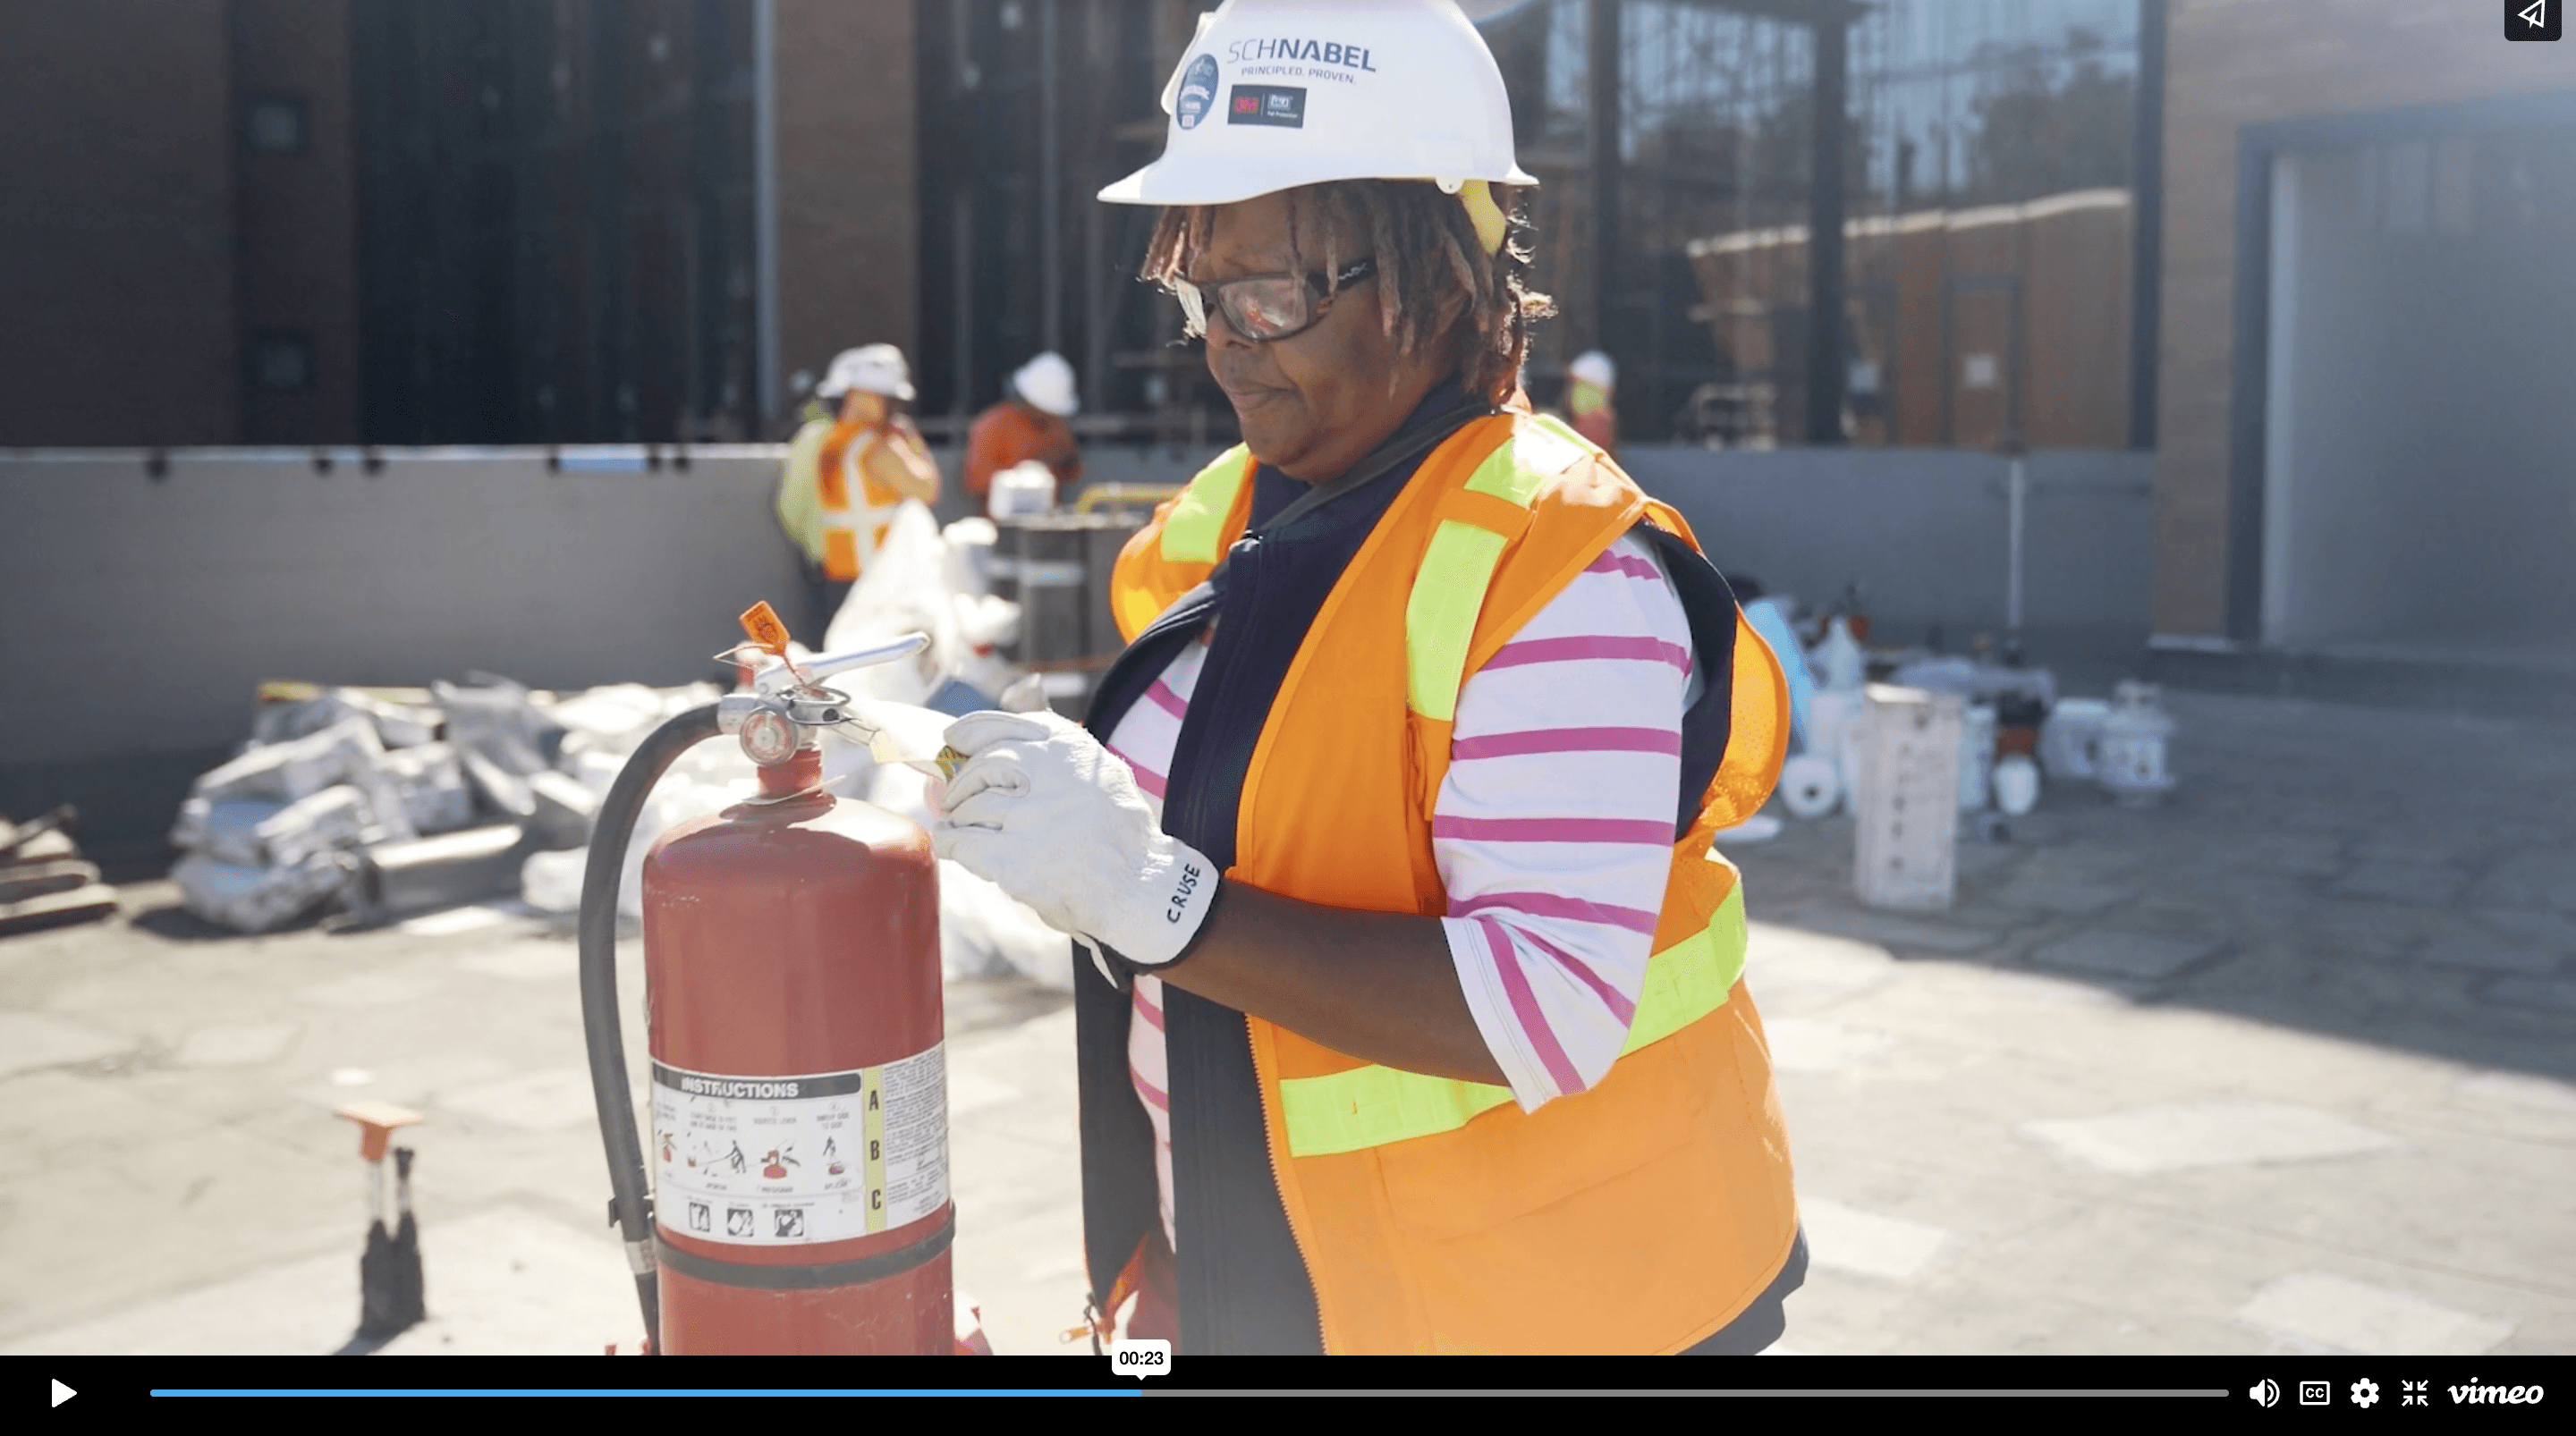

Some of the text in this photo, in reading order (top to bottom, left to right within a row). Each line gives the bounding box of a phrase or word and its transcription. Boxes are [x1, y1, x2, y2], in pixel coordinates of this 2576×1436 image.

[1226, 38, 1377, 72] SCHNABEL
[1241, 65, 1357, 85] PRINCIPLED. PROVEN.
[1166, 863, 1200, 924] CRUSE
[681, 1077, 799, 1098] INSTRUCTIONS
[868, 1089, 879, 1111] A
[869, 1139, 880, 1161] B
[870, 1188, 881, 1210] C
